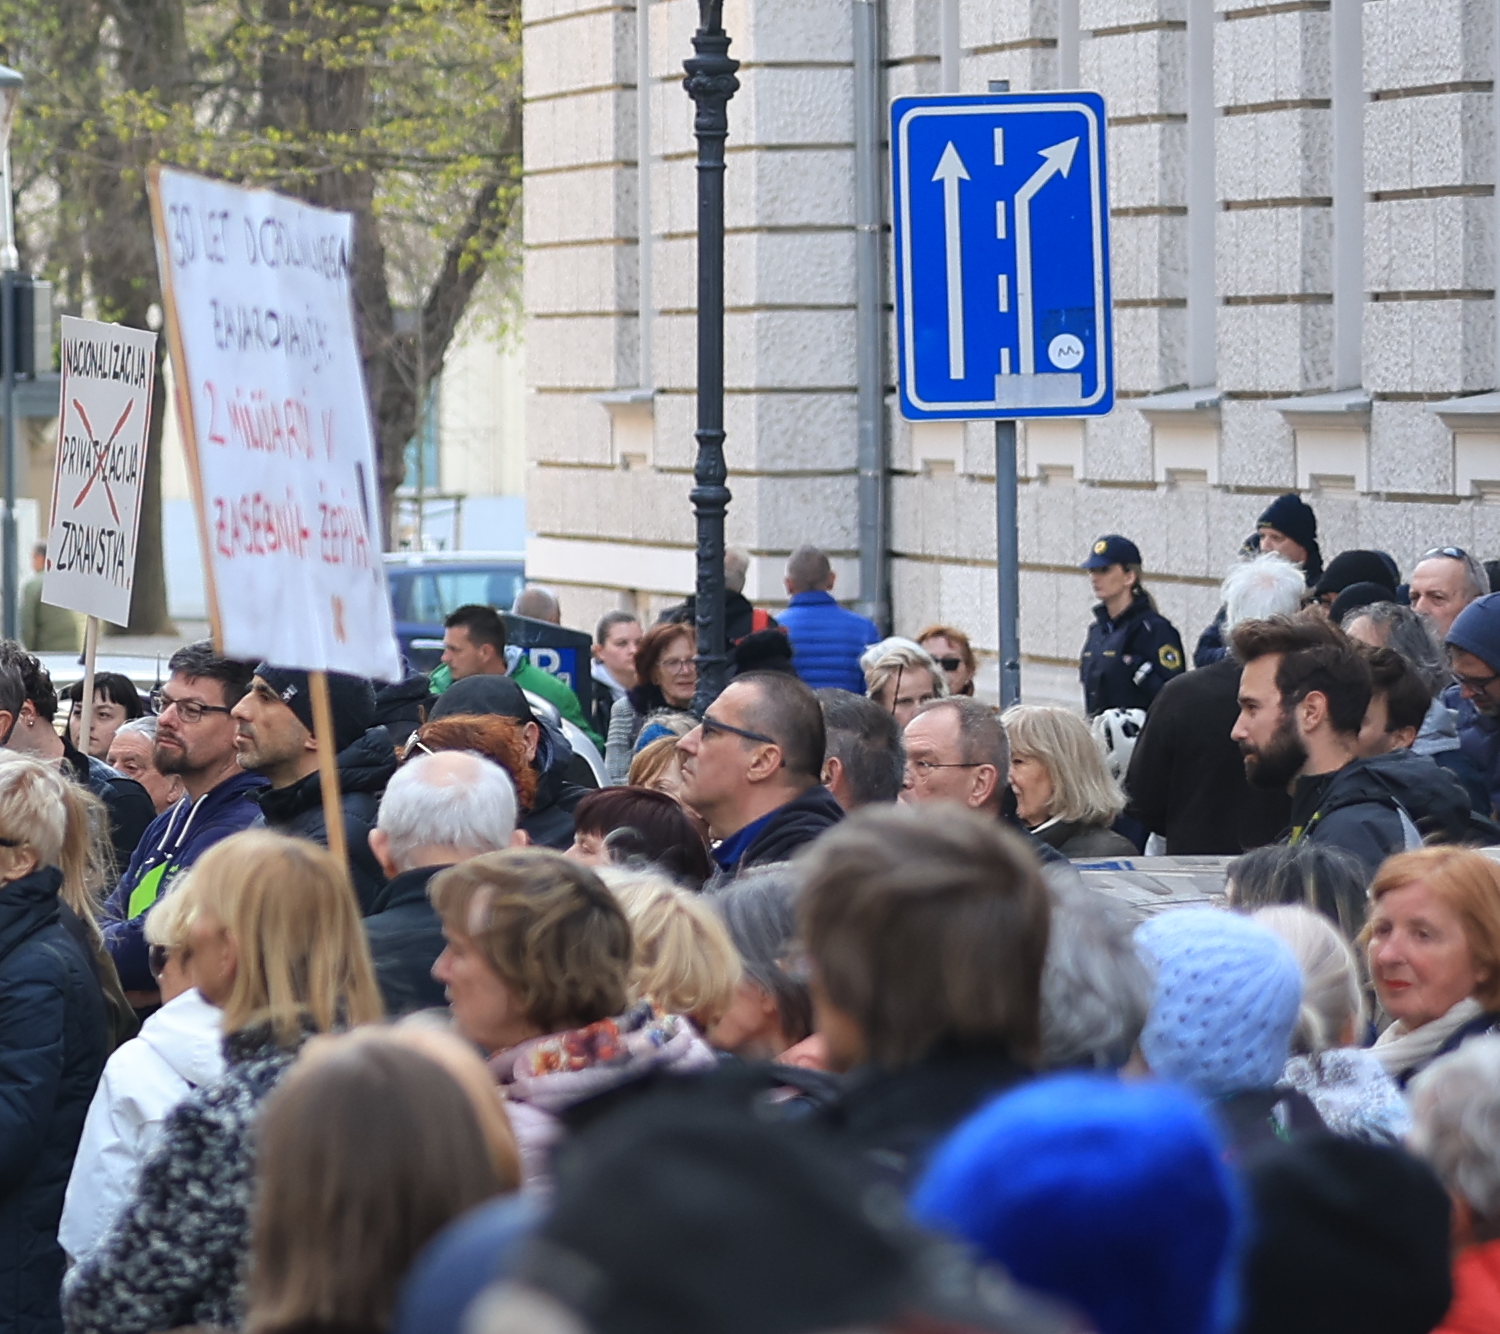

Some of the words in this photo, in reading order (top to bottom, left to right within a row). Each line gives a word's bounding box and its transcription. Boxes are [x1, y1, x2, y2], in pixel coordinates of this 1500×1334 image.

[66, 337, 146, 390] NACIONALIZACIJA
[61, 436, 139, 486] PRIVATIZACIJA
[57, 521, 127, 589] ZDRAVSTVA
